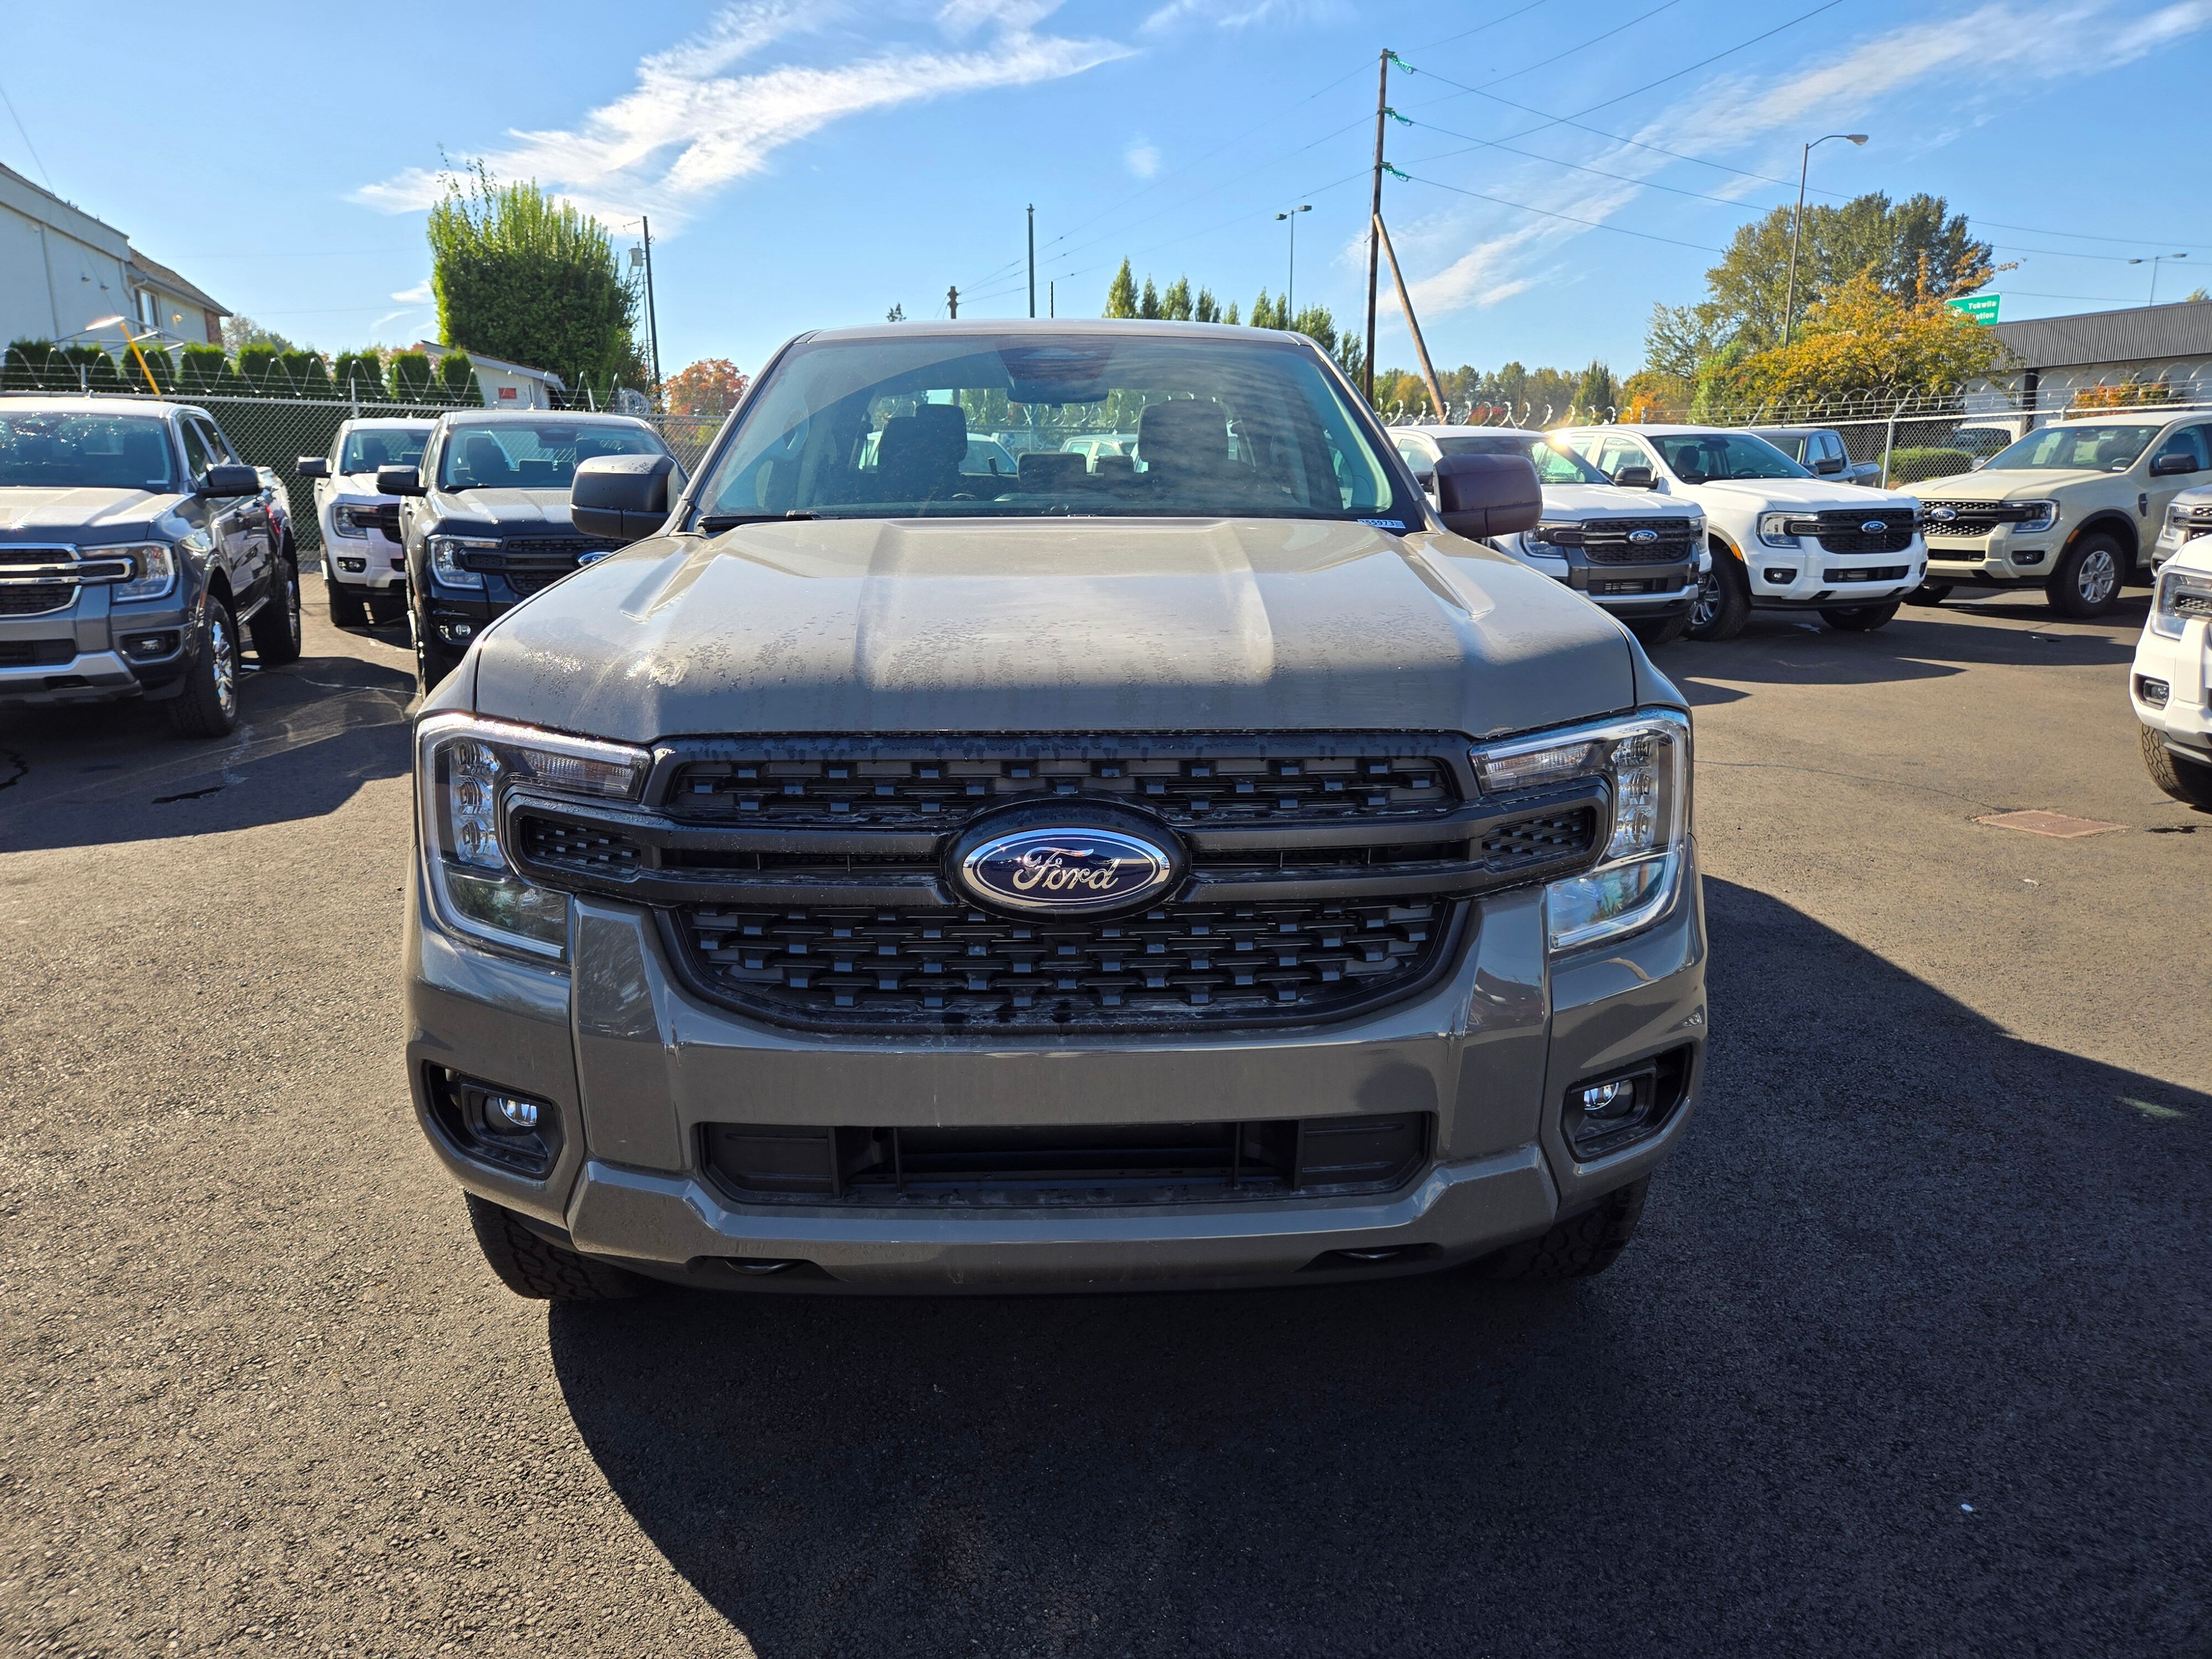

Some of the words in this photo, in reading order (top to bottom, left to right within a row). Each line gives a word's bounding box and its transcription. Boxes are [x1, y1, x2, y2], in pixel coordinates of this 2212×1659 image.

[1968, 300, 1996, 310] Tukwila
[1975, 312, 1995, 320] ation
[1013, 846, 1122, 890] Ford
